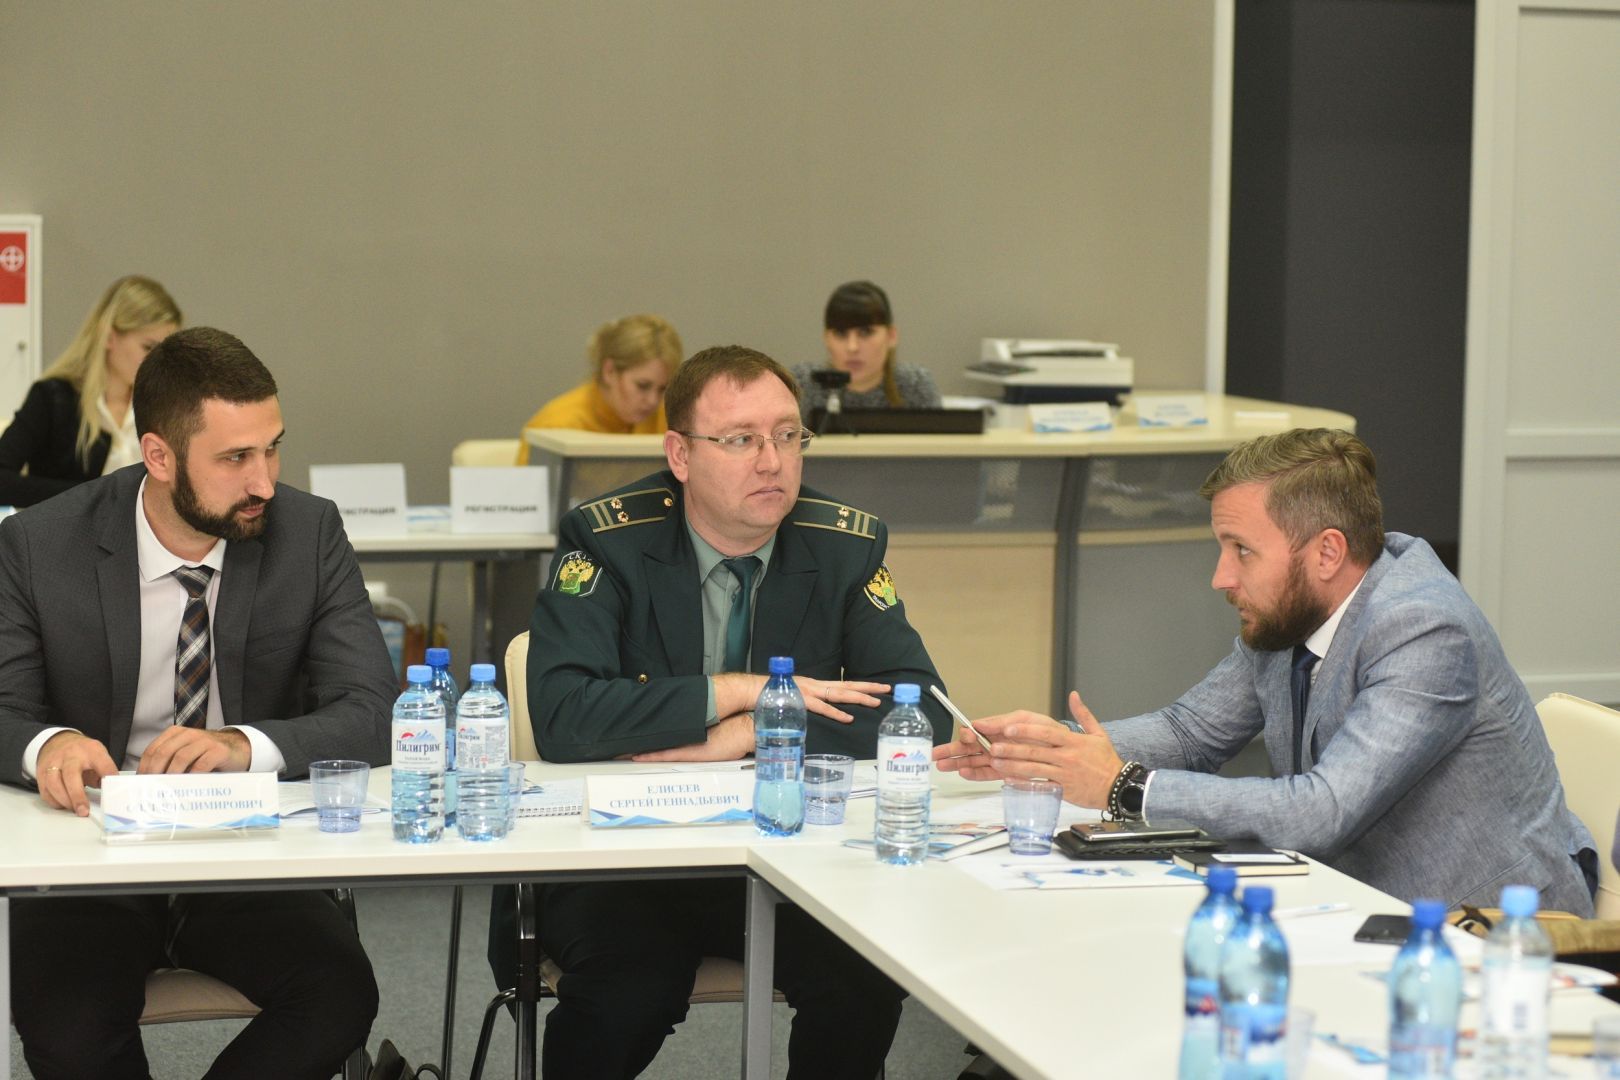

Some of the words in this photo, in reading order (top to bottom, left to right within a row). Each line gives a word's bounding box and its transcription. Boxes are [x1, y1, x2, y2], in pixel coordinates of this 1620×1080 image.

[463, 504, 538, 513] РЕГИСТРАЦИЯ
[396, 739, 440, 756] Пилигрим
[887, 760, 930, 776] Пилигрим
[647, 784, 700, 794] ЕЛИСЕЕВ
[610, 797, 653, 808] СЕРГЕЙ
[656, 795, 740, 807] ГЕННАДЬЕВИЧ
